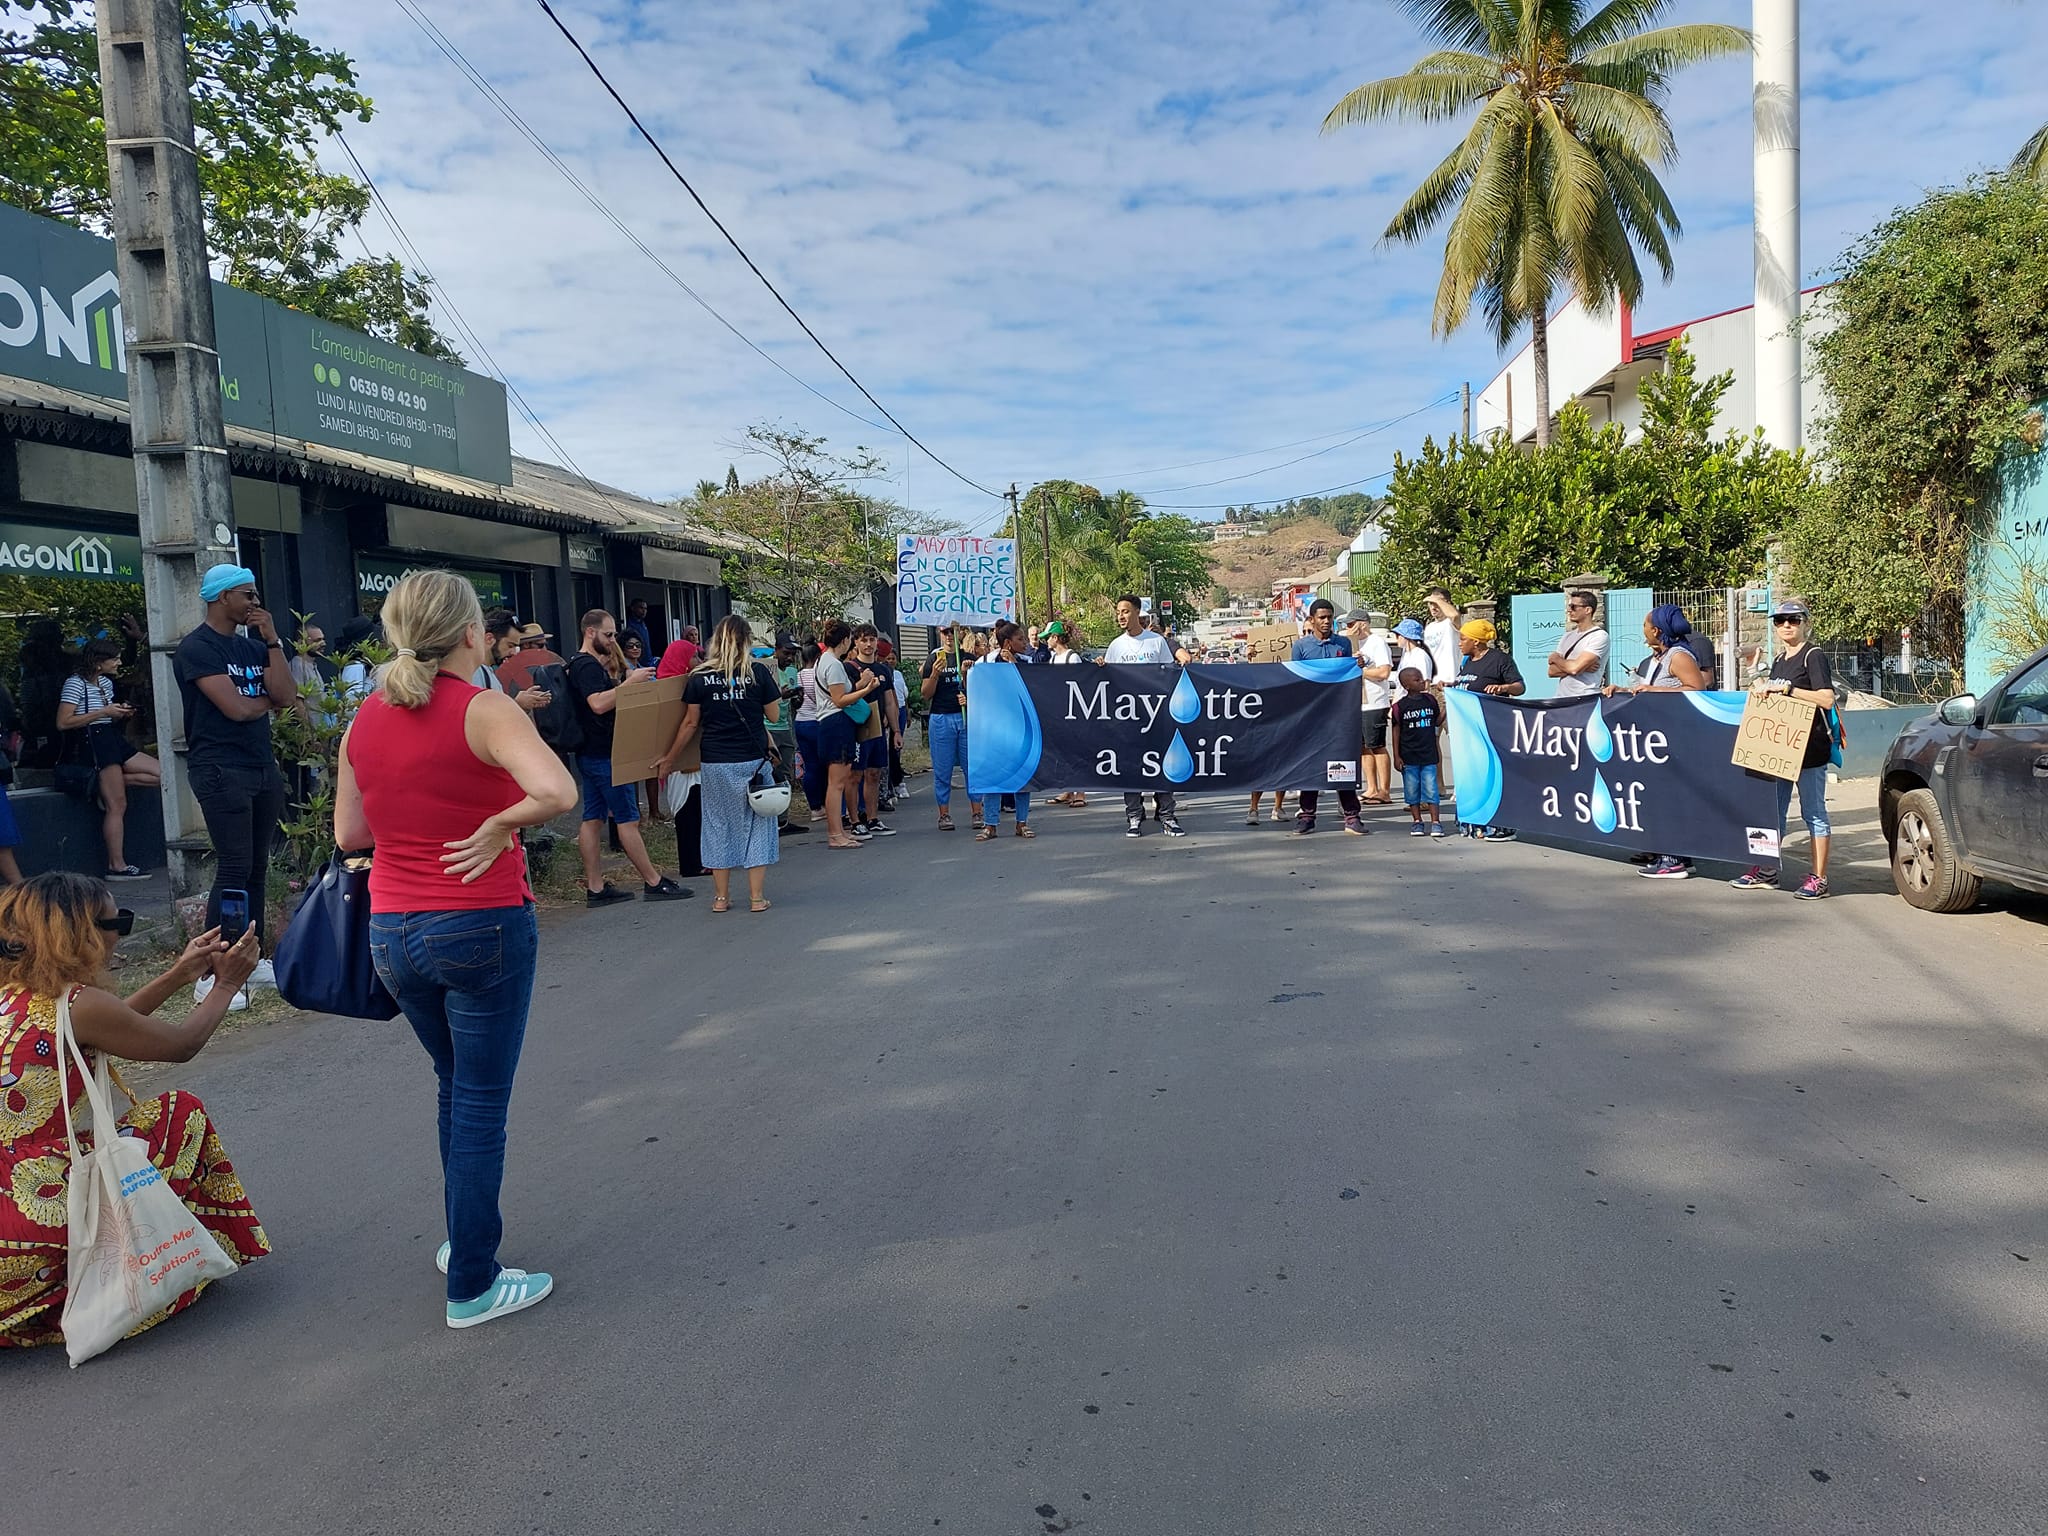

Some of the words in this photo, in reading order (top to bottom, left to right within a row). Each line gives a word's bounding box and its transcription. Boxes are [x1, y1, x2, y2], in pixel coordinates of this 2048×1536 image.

[349, 375, 378, 398] 0639
[381, 386, 395, 403] 69
[397, 391, 412, 408] 42
[413, 395, 427, 412] 90
[409, 362, 417, 381] à
[420, 370, 445, 390] petit
[447, 377, 465, 397] prix
[316, 390, 347, 412] LUNDI
[348, 400, 361, 416] AU
[362, 402, 406, 427] VENDREDI
[407, 417, 427, 433] 8H30
[432, 423, 457, 441] 17H30
[319, 413, 356, 435] SAMEDI
[357, 424, 379, 441] 8H30
[386, 431, 412, 449] 16H00
[915, 537, 993, 554] MAYOTTE
[899, 551, 928, 573] EN
[713, 691, 720, 700] a
[1748, 690, 1815, 721] MAYOTTE
[1745, 716, 1807, 750] CRÈVE
[1095, 748, 1121, 776] a
[1735, 747, 1753, 766] DE
[1542, 785, 1562, 817] a
[120, 1166, 156, 1187] renew
[121, 1172, 161, 1198] europe
[139, 1226, 196, 1266] Outre-Mer
[149, 1248, 200, 1285] Solutions
